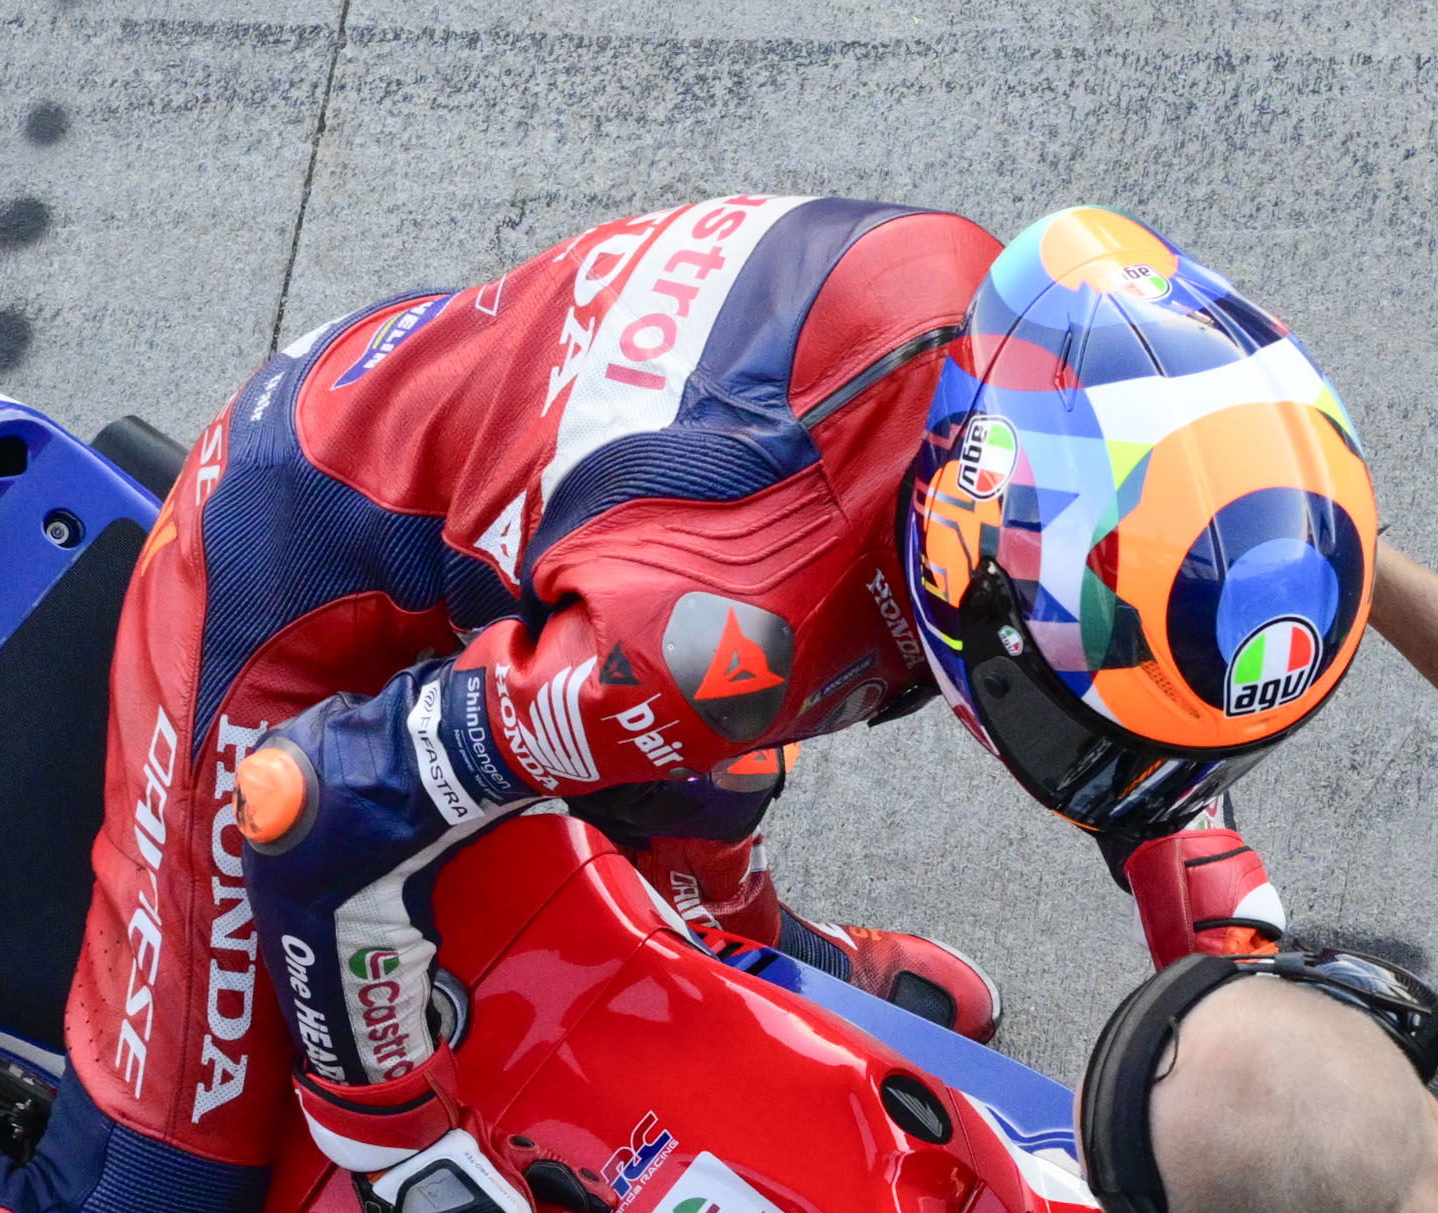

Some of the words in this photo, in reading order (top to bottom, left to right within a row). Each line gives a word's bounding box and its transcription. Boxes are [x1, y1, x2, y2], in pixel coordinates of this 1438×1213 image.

[605, 199, 765, 391] strol
[959, 423, 988, 487] agv
[866, 568, 925, 670] HONDA
[466, 677, 512, 789] ShinDengen
[494, 664, 560, 791] HONDA
[1233, 673, 1313, 713] agv
[418, 716, 469, 818] FIFASTRA
[116, 706, 178, 1099] DAINESE
[192, 714, 268, 1124] HONDA
[281, 934, 316, 999] One
[294, 998, 350, 1086] HEAR
[358, 980, 414, 1081] Castro
[640, 1138, 679, 1185] RACING
